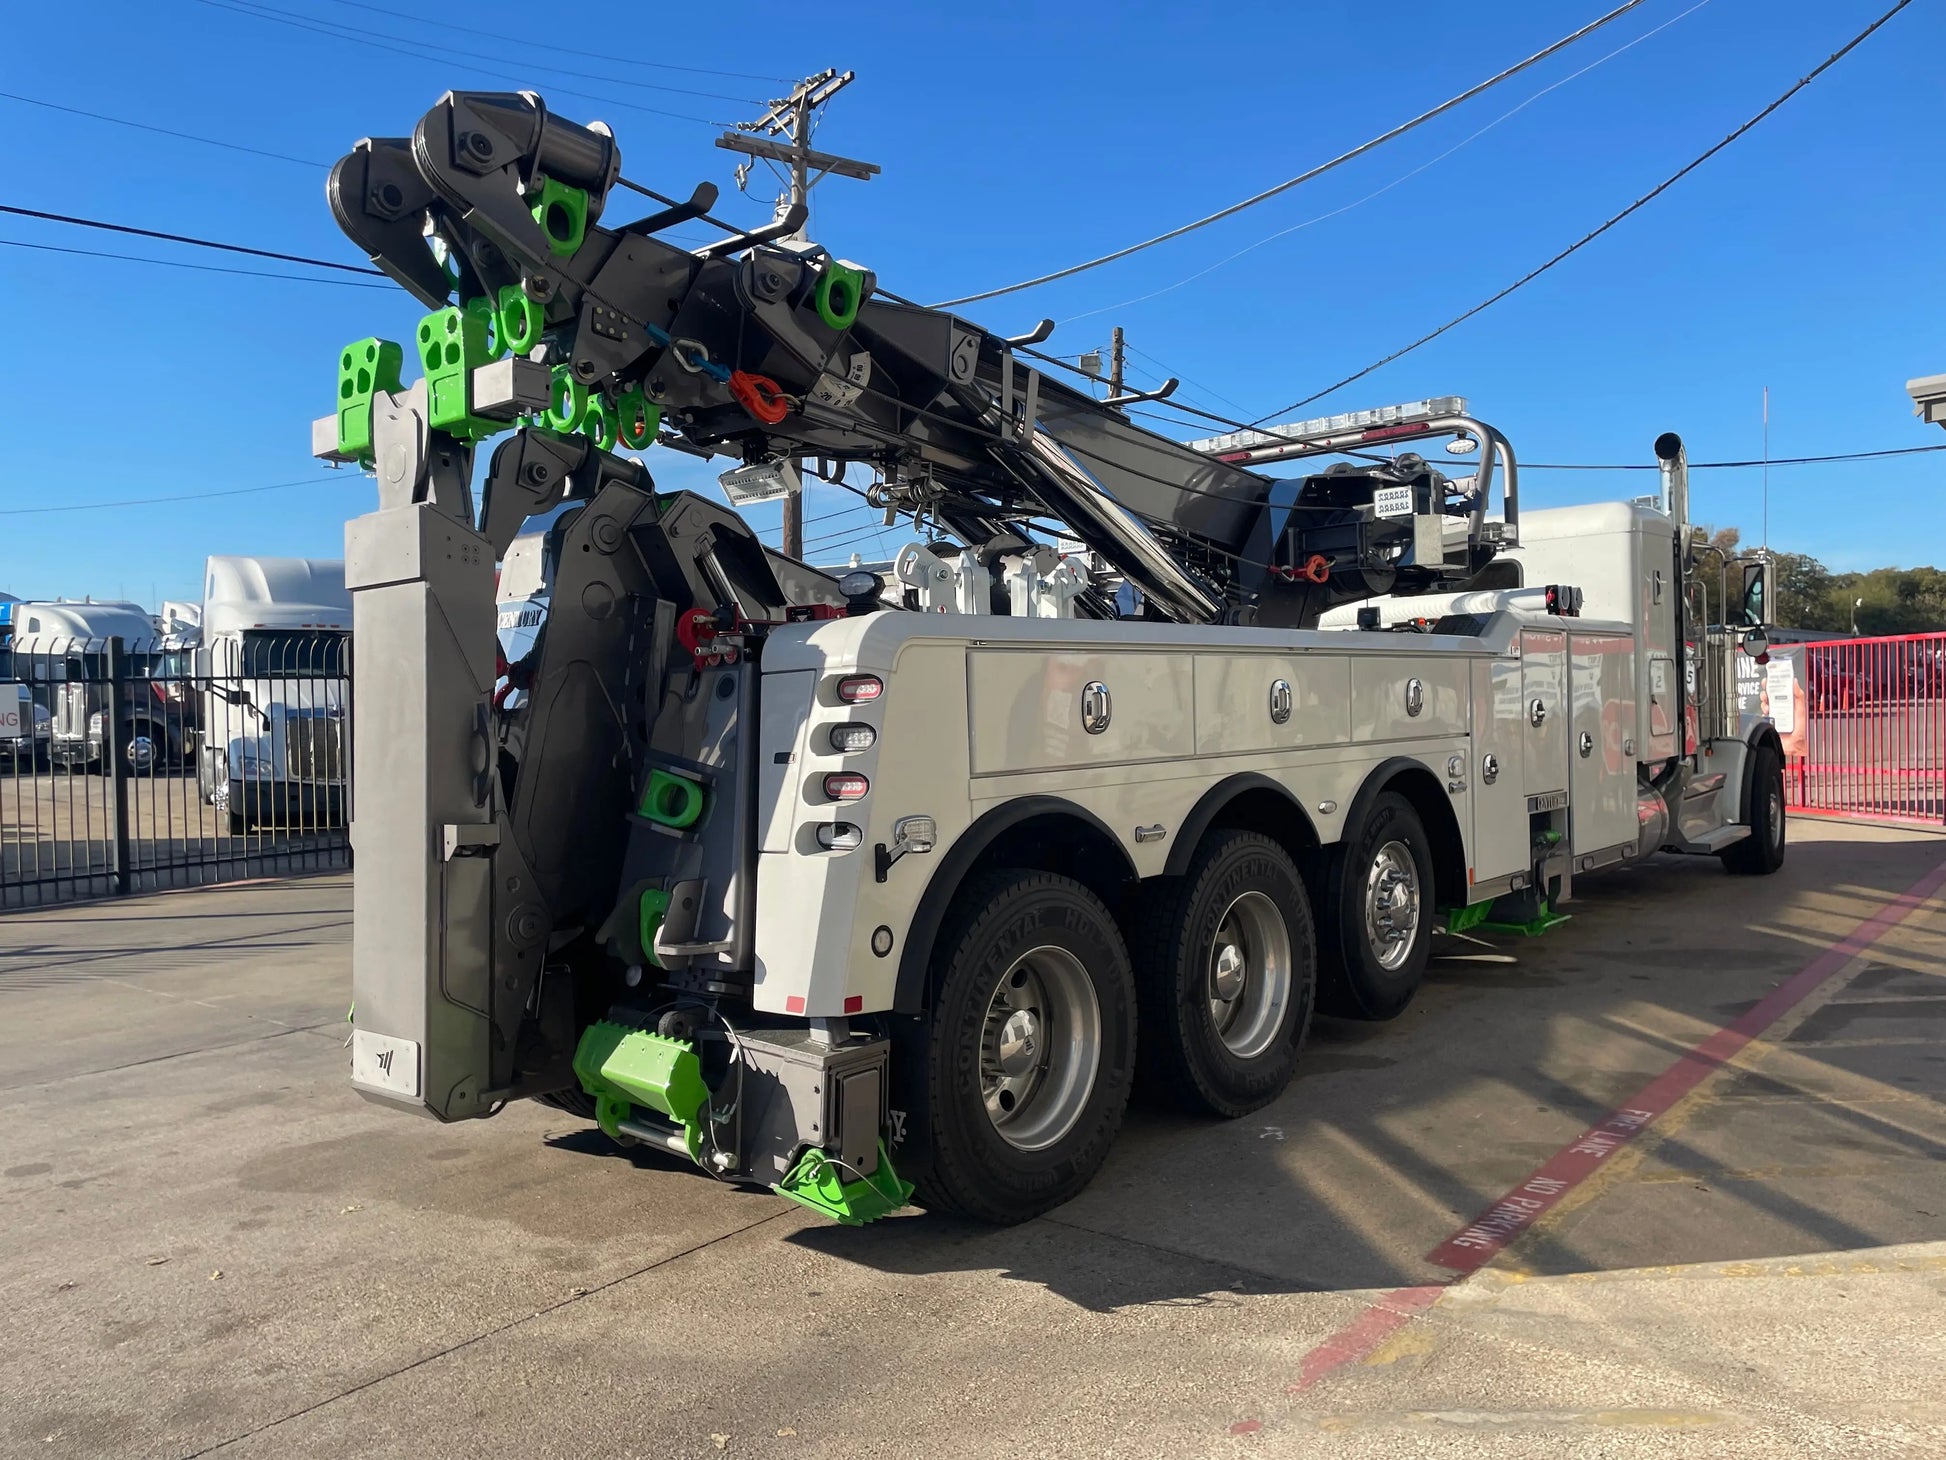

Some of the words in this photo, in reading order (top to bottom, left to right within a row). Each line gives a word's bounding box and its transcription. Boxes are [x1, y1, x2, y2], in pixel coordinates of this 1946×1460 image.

[498, 609, 543, 630] CENTURY
[1608, 1108, 1654, 1130] FIRE
[1569, 1130, 1627, 1158] LANE
[1524, 1176, 1569, 1195] NO
[1452, 1195, 1544, 1250] PARKING
